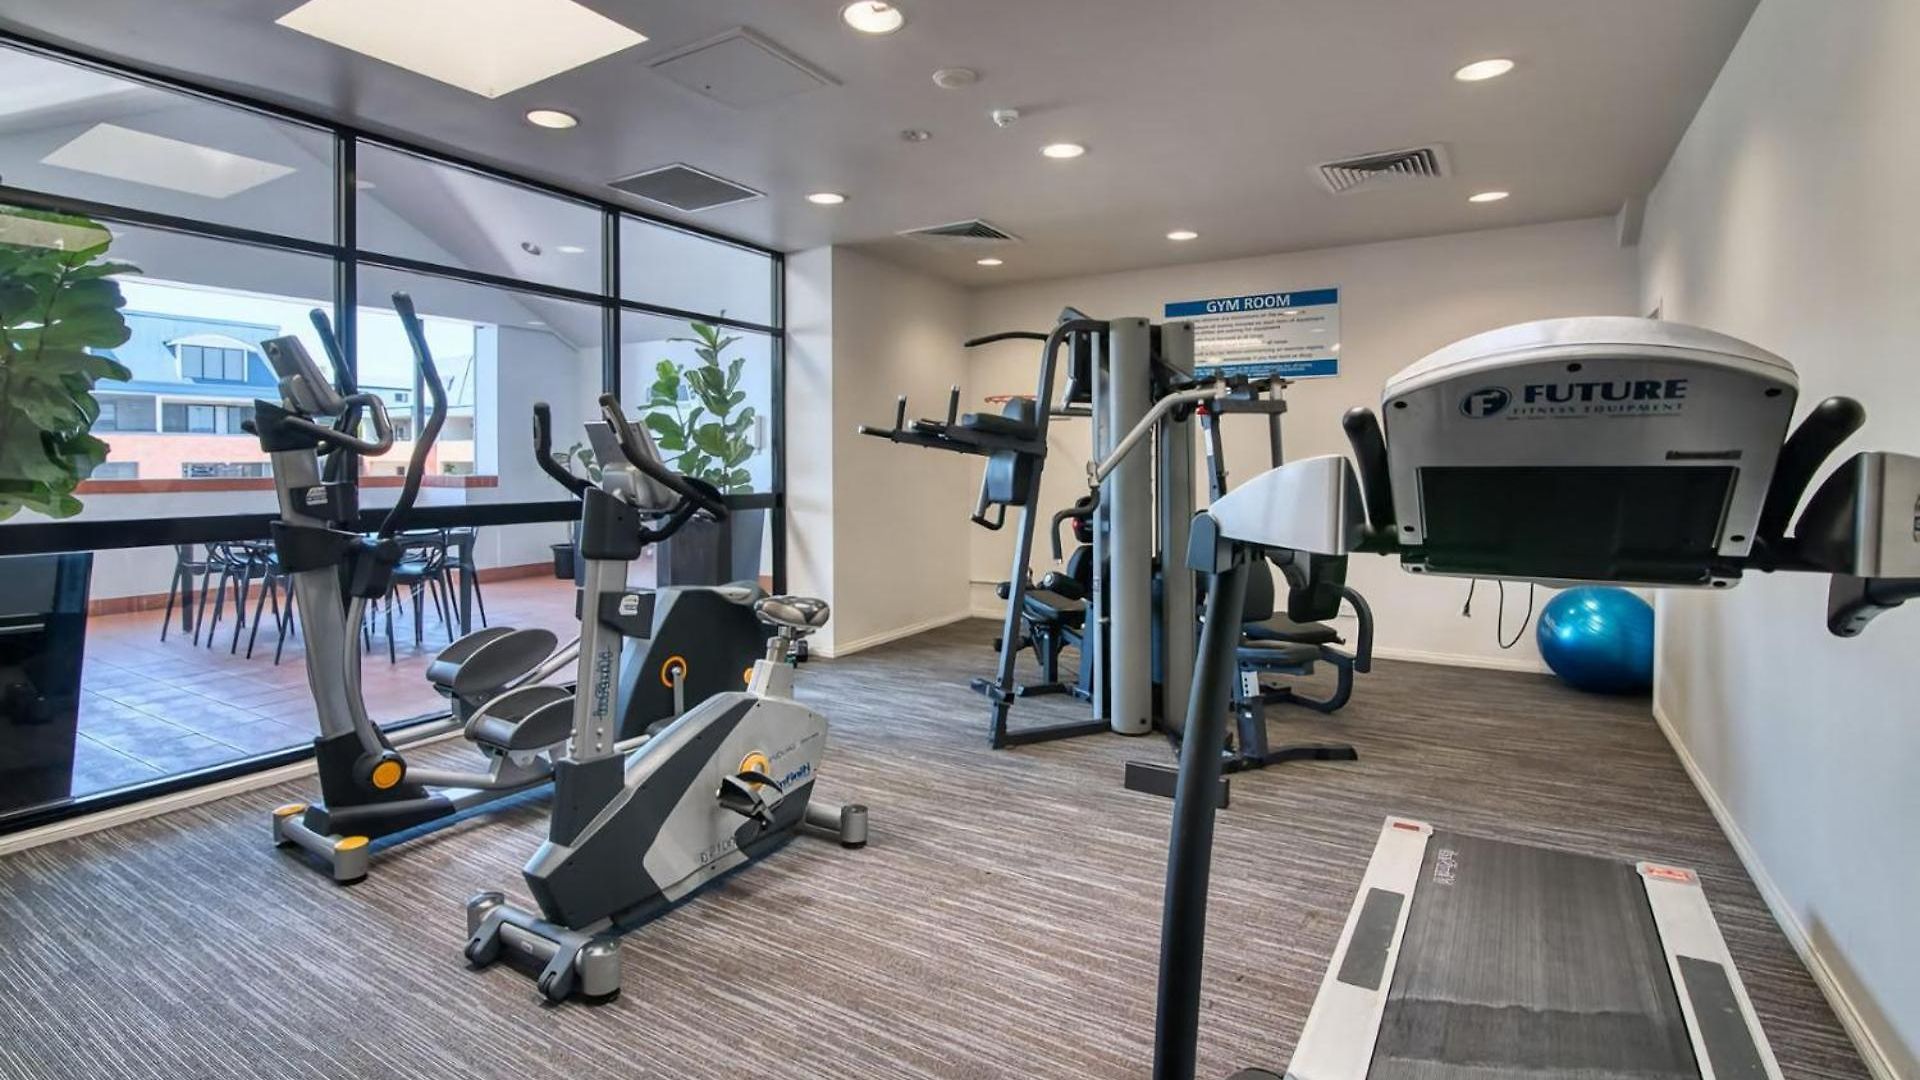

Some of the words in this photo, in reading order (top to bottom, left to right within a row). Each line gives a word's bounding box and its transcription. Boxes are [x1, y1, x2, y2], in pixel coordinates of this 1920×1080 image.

[1206, 299, 1240, 313] GYM
[1244, 294, 1291, 309] ROOM
[1524, 379, 1688, 403] FUTURE
[1513, 406, 1576, 415] FITNESS
[1584, 402, 1683, 414] EQUIPMENT
